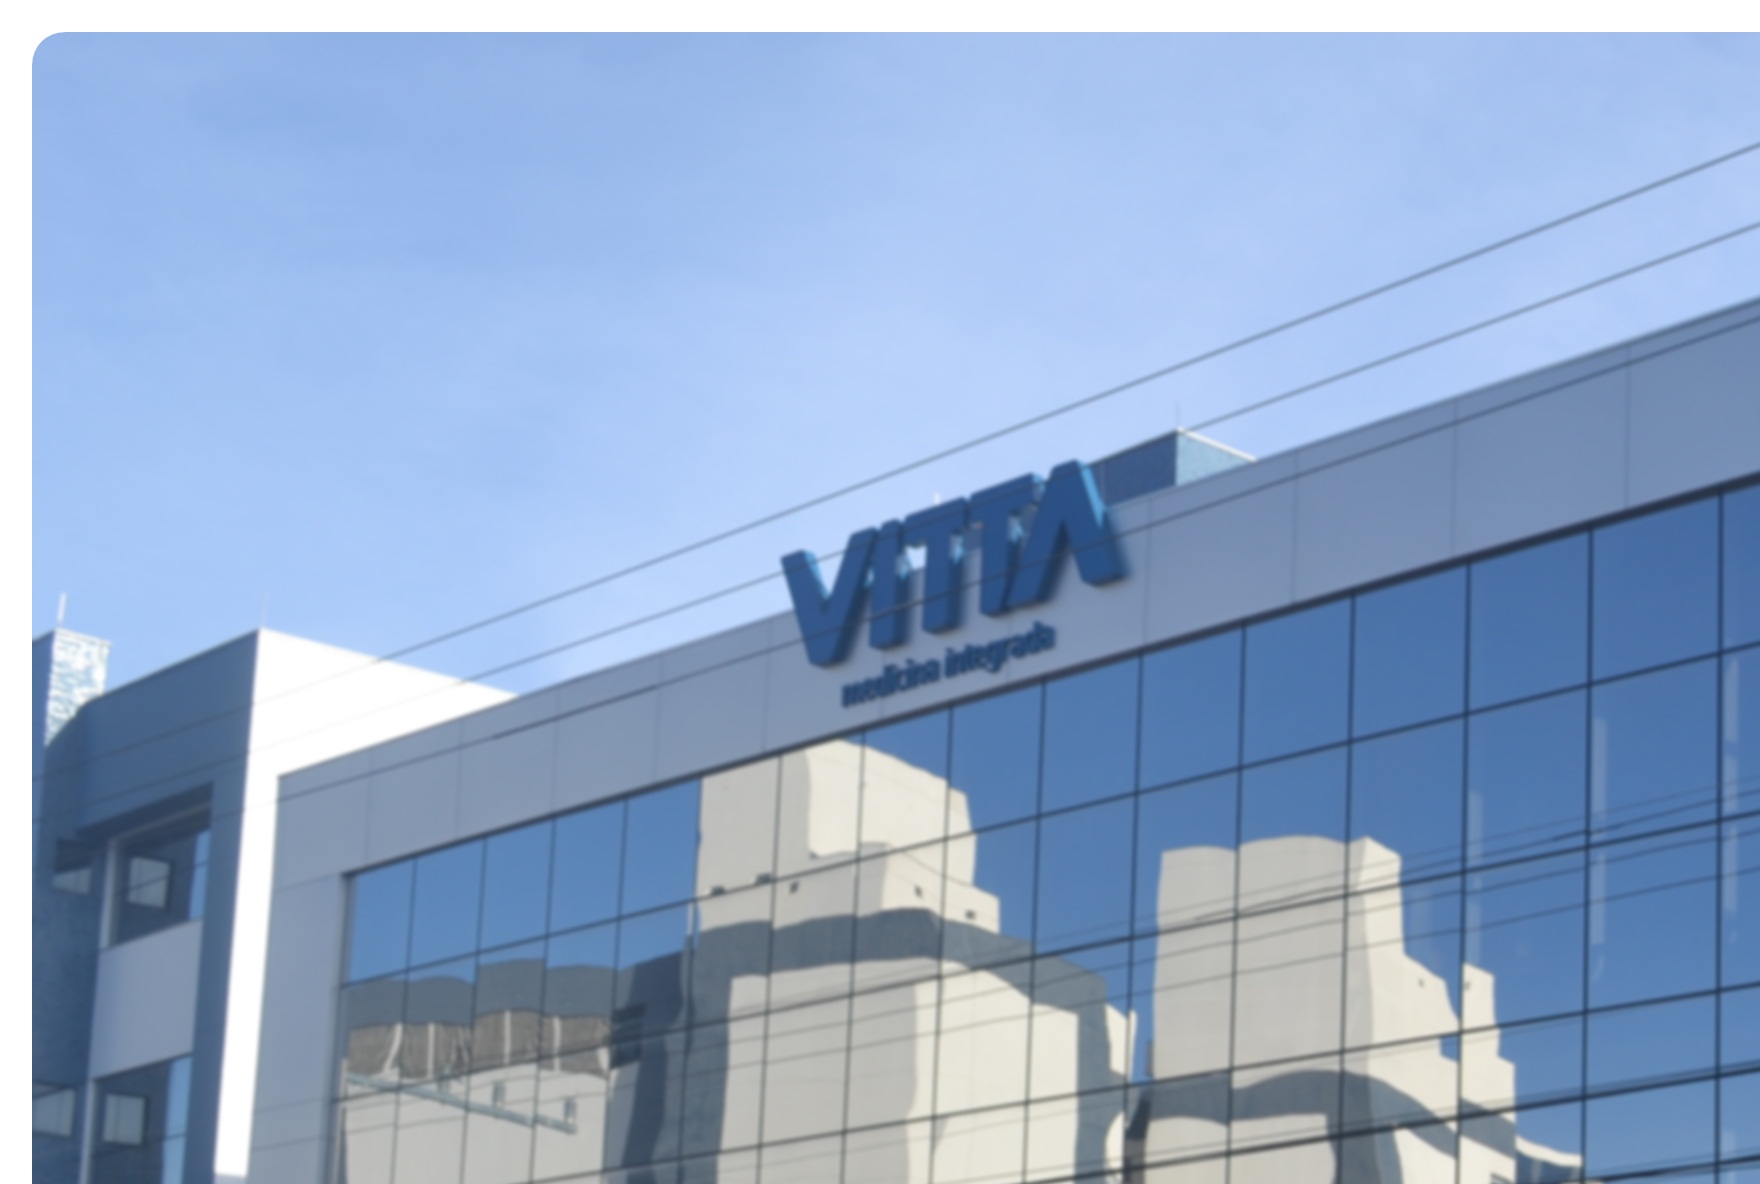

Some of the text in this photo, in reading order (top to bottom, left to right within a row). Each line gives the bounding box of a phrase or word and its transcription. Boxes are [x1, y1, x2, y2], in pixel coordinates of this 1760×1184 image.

[781, 459, 1129, 667] VITTA
[841, 621, 1055, 708] medicina integrada
